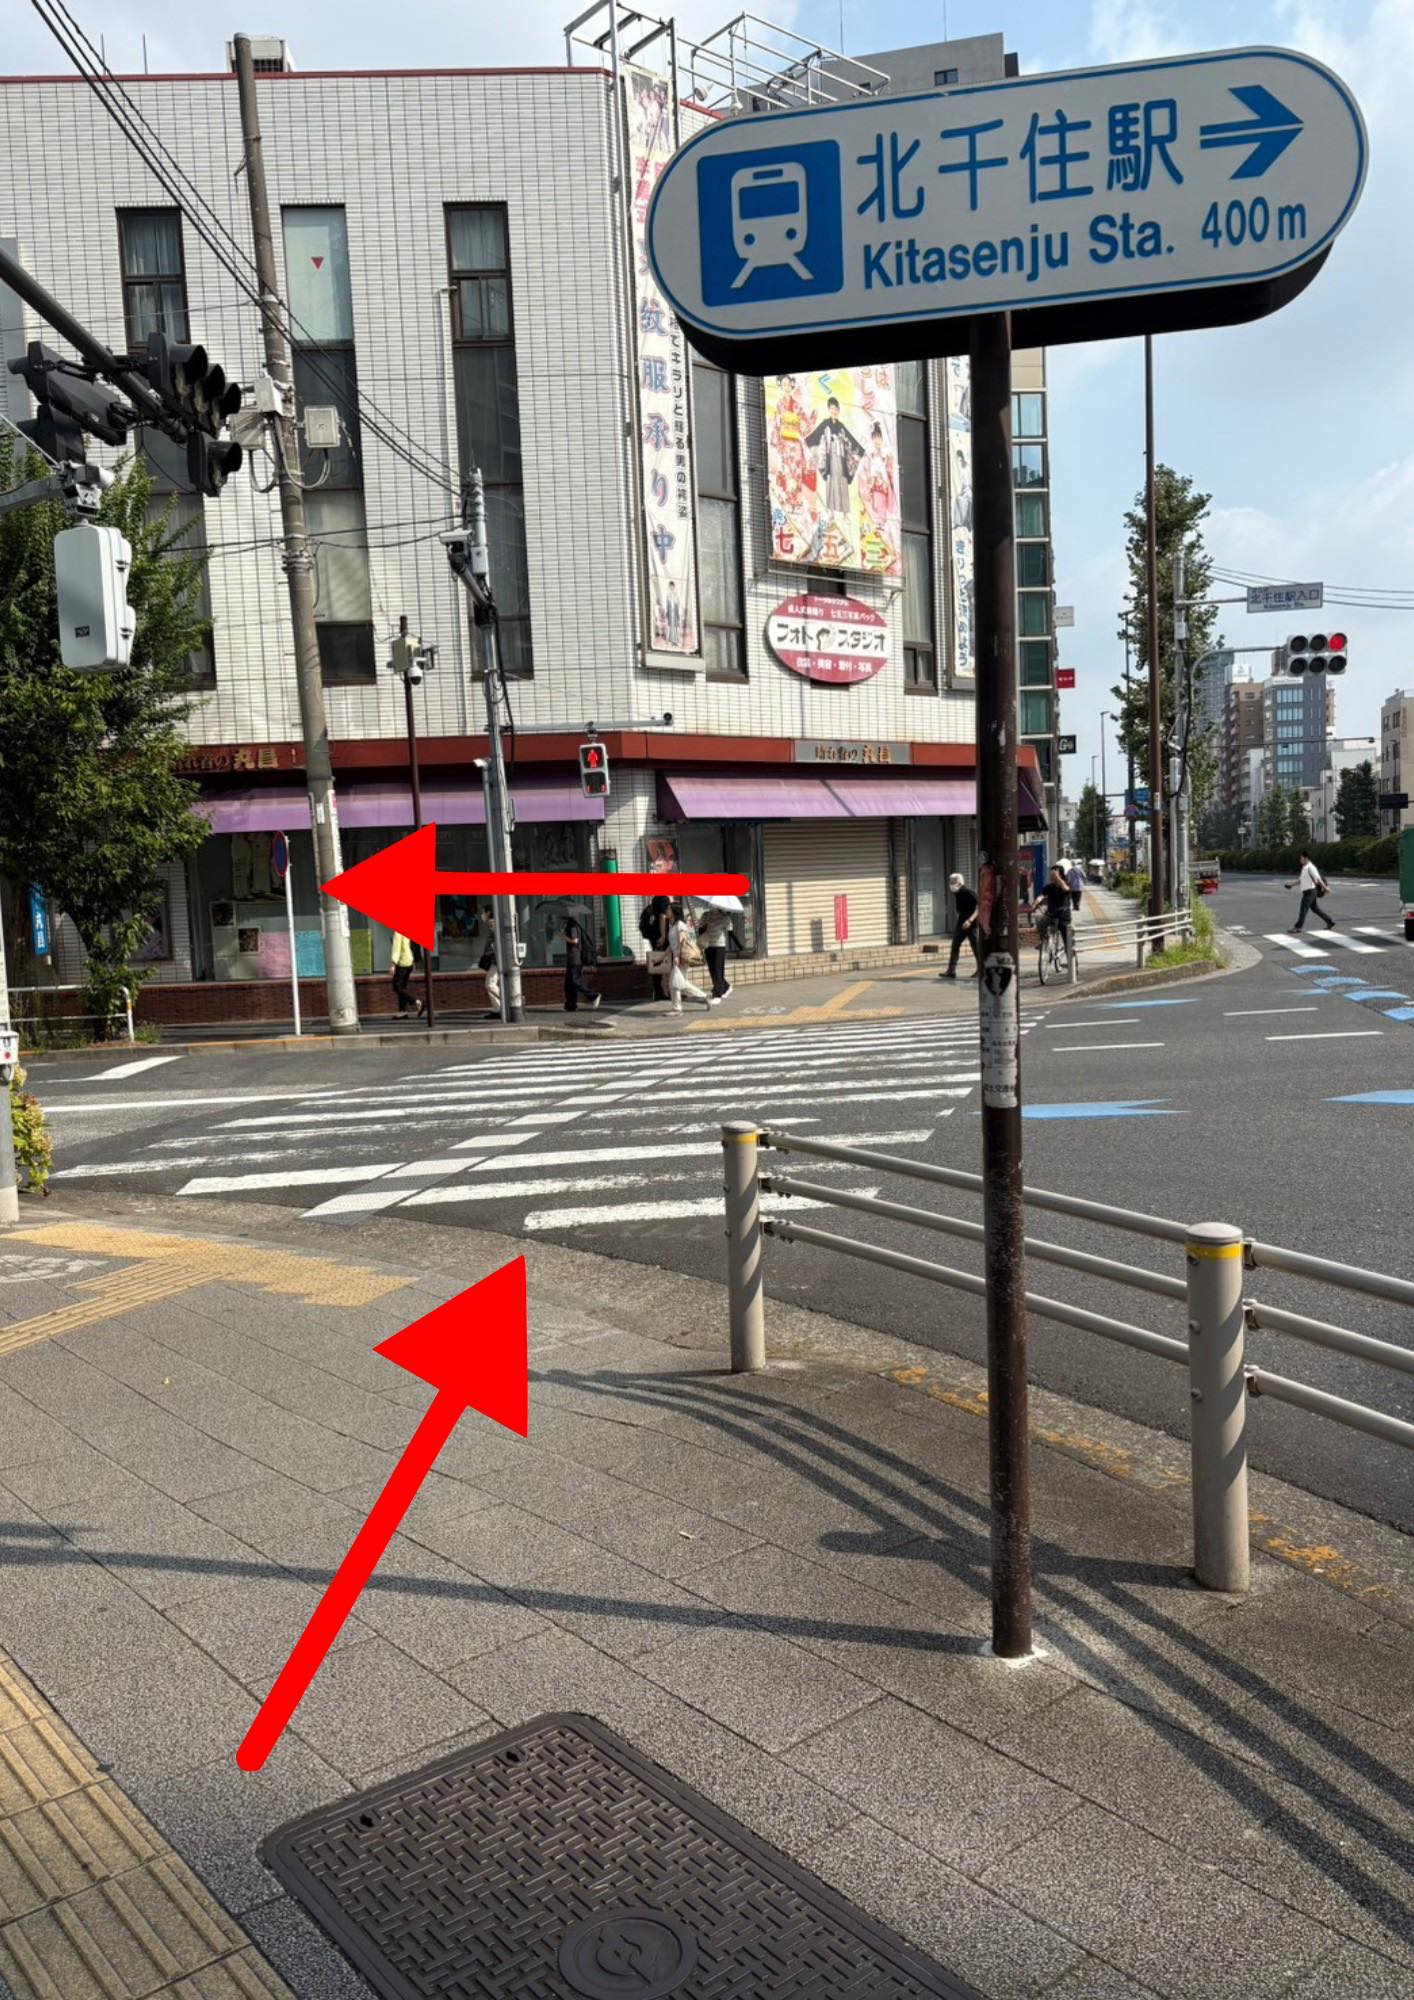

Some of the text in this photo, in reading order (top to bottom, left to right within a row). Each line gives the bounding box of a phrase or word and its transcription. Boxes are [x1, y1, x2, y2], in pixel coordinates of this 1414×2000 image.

[856, 97, 1184, 224] 北千住駅
[863, 224, 1068, 290] Kitasenju
[1089, 212, 1174, 264] Sta.
[1250, 589, 1320, 604] 北千住駅入口
[777, 623, 885, 652] フォト スタジオ
